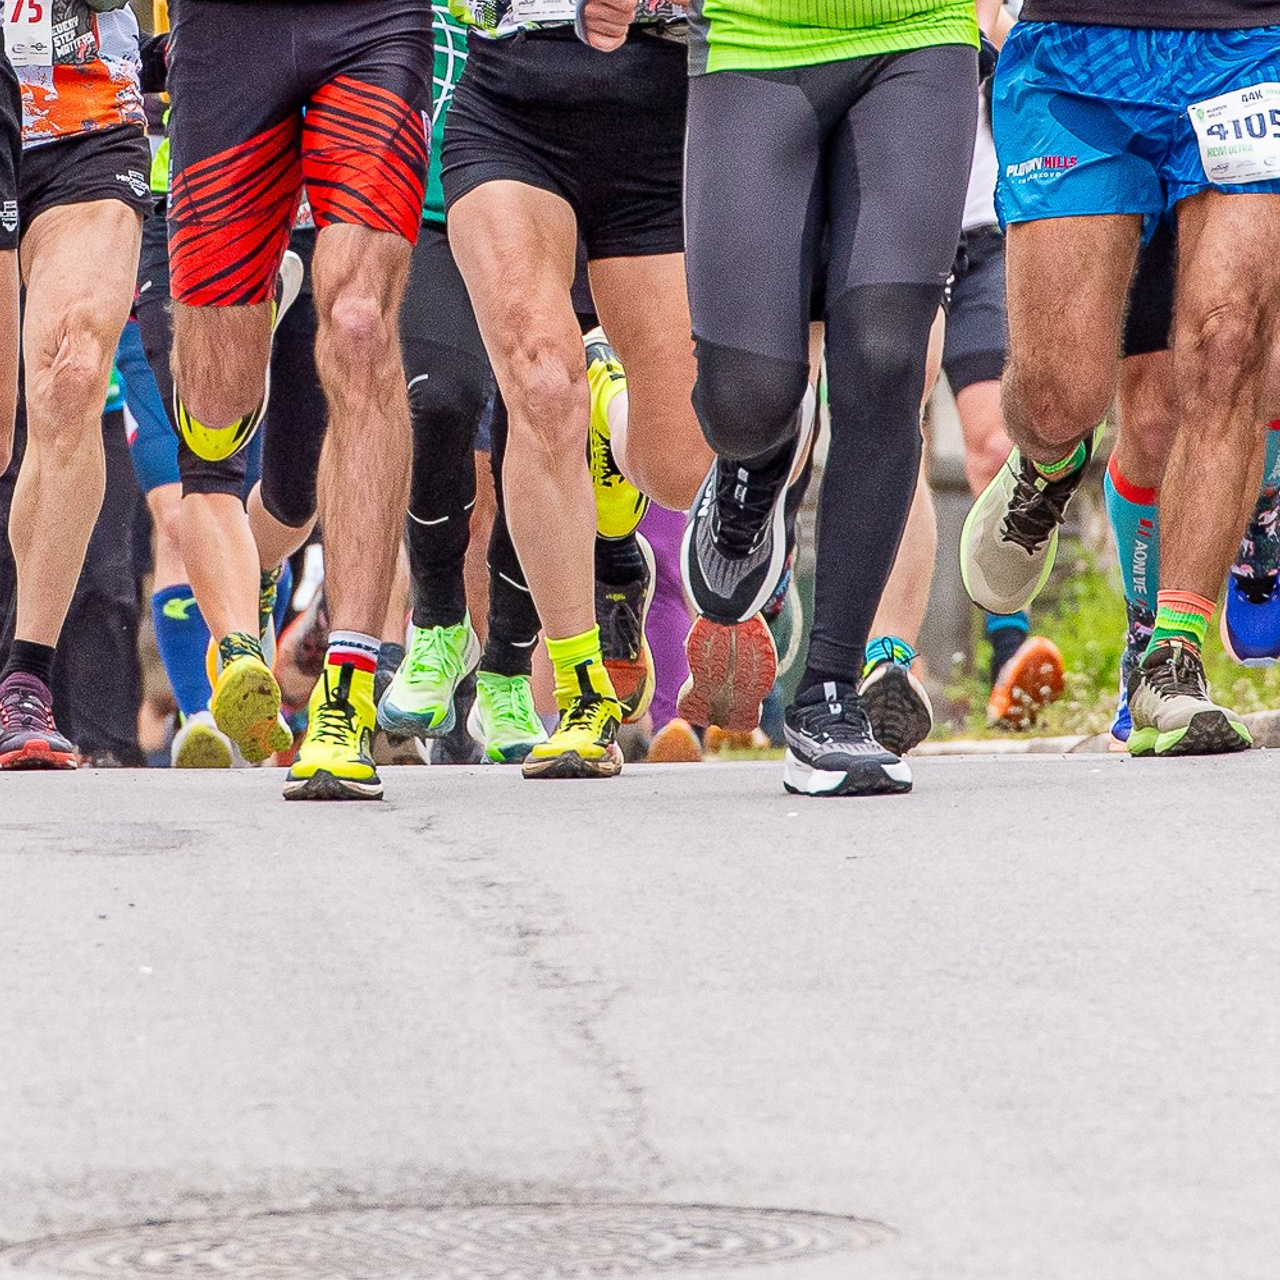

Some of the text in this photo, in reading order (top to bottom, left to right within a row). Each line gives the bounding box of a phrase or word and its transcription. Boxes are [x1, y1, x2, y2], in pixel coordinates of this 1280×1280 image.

[52, 15, 79, 37] EVERY
[52, 29, 76, 48] STEP
[1241, 89, 1263, 103] 44K
[1206, 108, 1280, 141] 4105
[1044, 155, 1078, 169] HILLS
